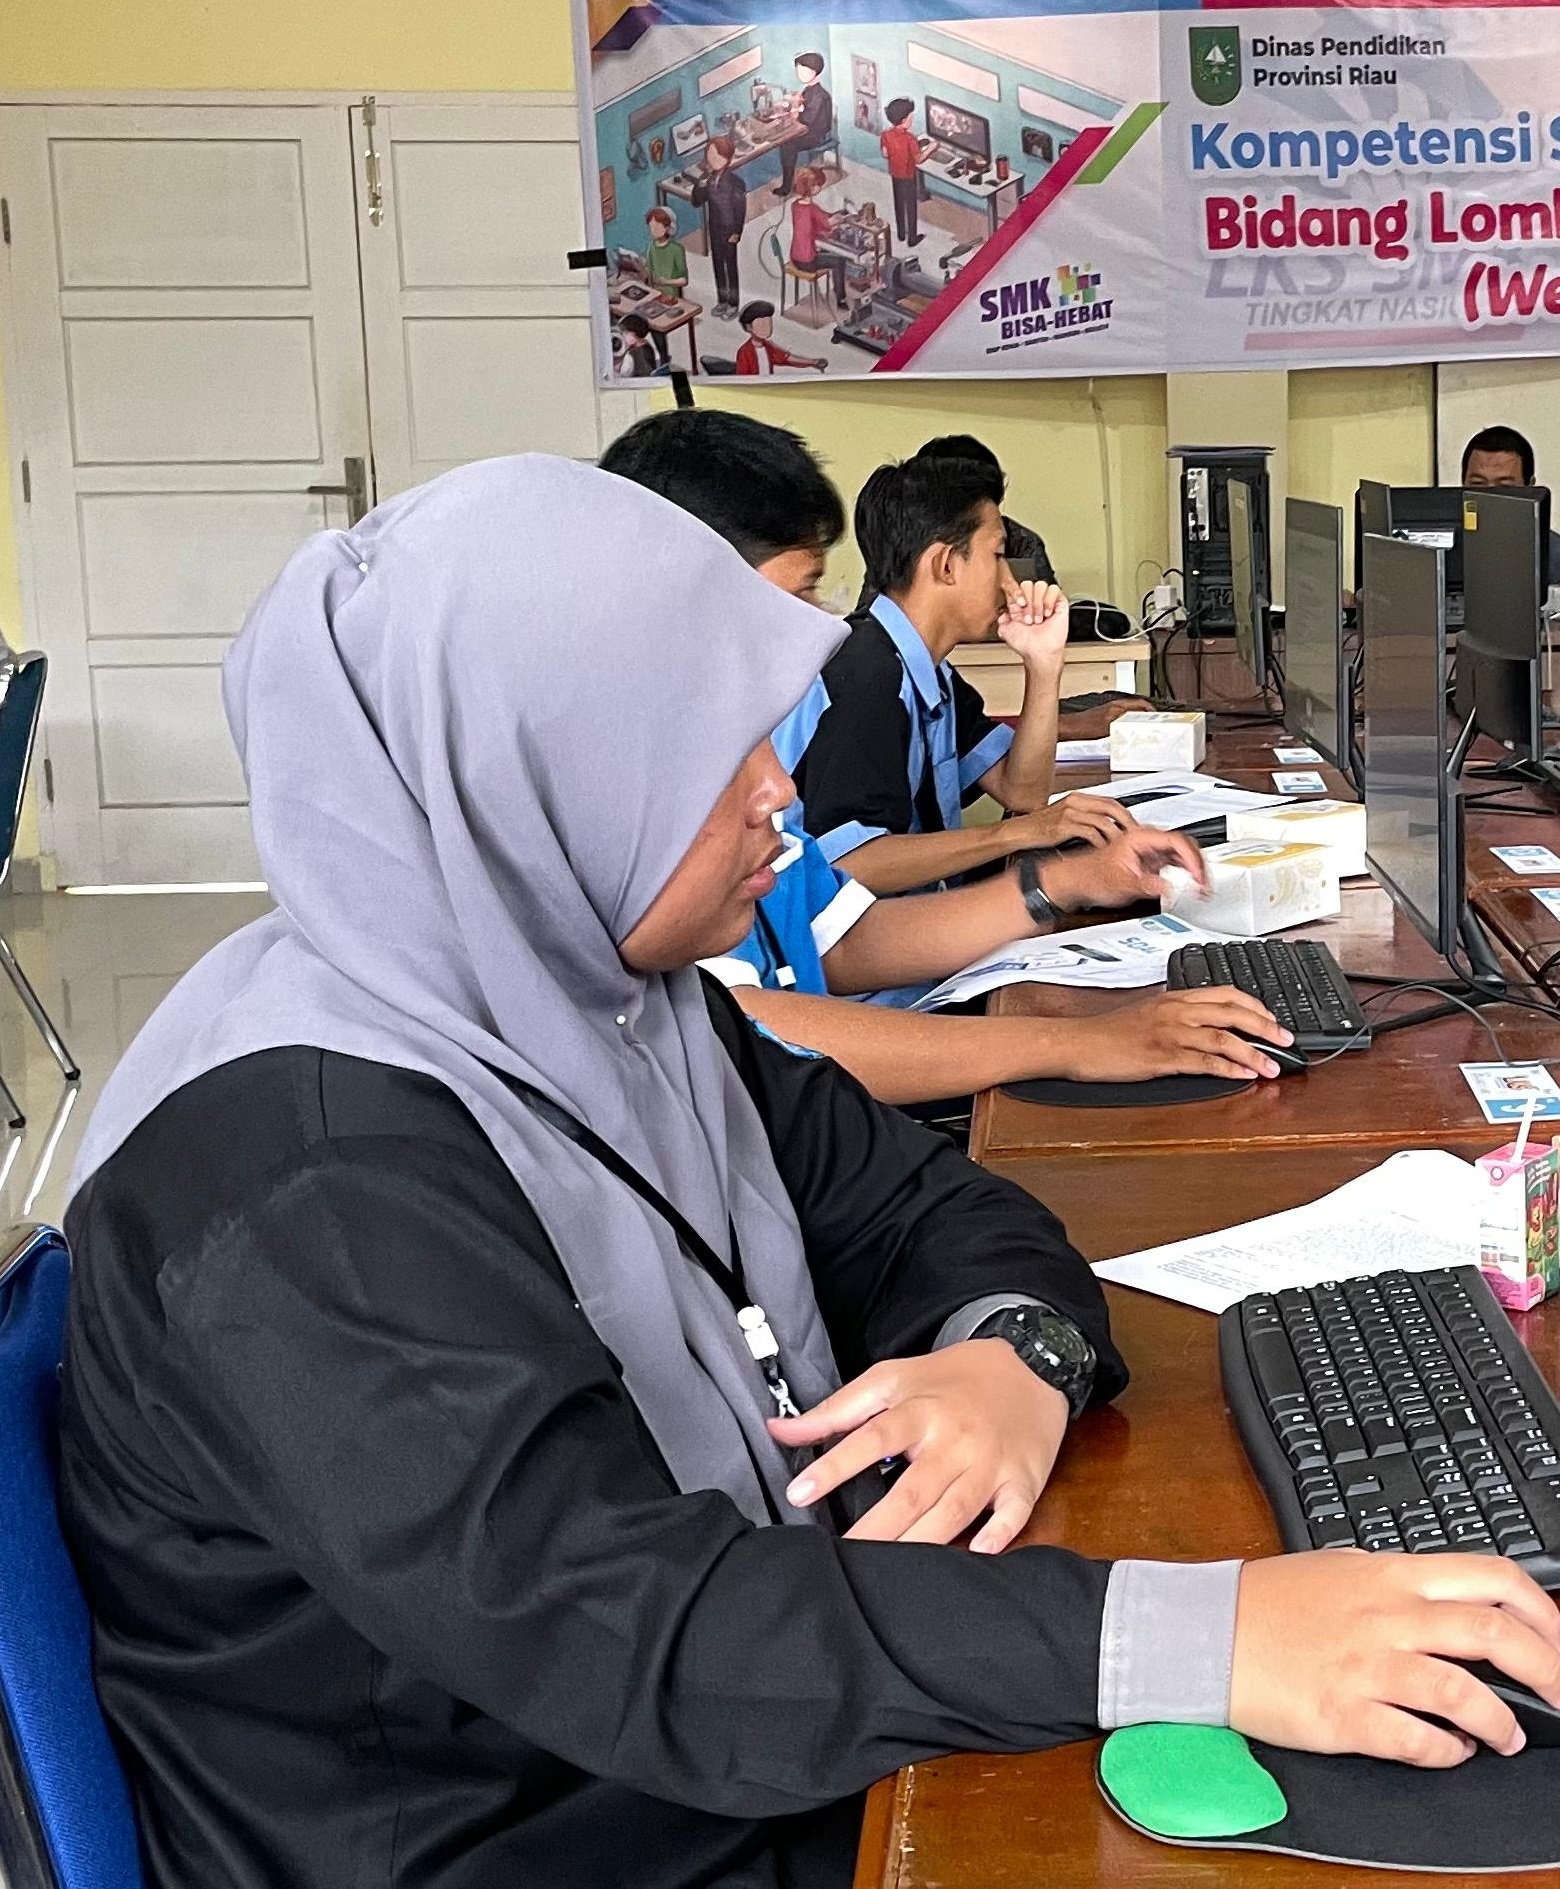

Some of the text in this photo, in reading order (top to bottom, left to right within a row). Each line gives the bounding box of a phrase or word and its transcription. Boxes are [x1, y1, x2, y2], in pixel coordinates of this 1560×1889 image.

[1252, 35, 1446, 57] Dinas Pendidikan
[1253, 65, 1397, 87] Provinsi Riau
[1190, 111, 1532, 179] Kompetensi
[1205, 194, 1409, 261] Bidang
[980, 277, 1051, 322] SMK
[1001, 299, 1114, 339] BISA-HEBAT
[1246, 299, 1373, 326] TINGKAT
